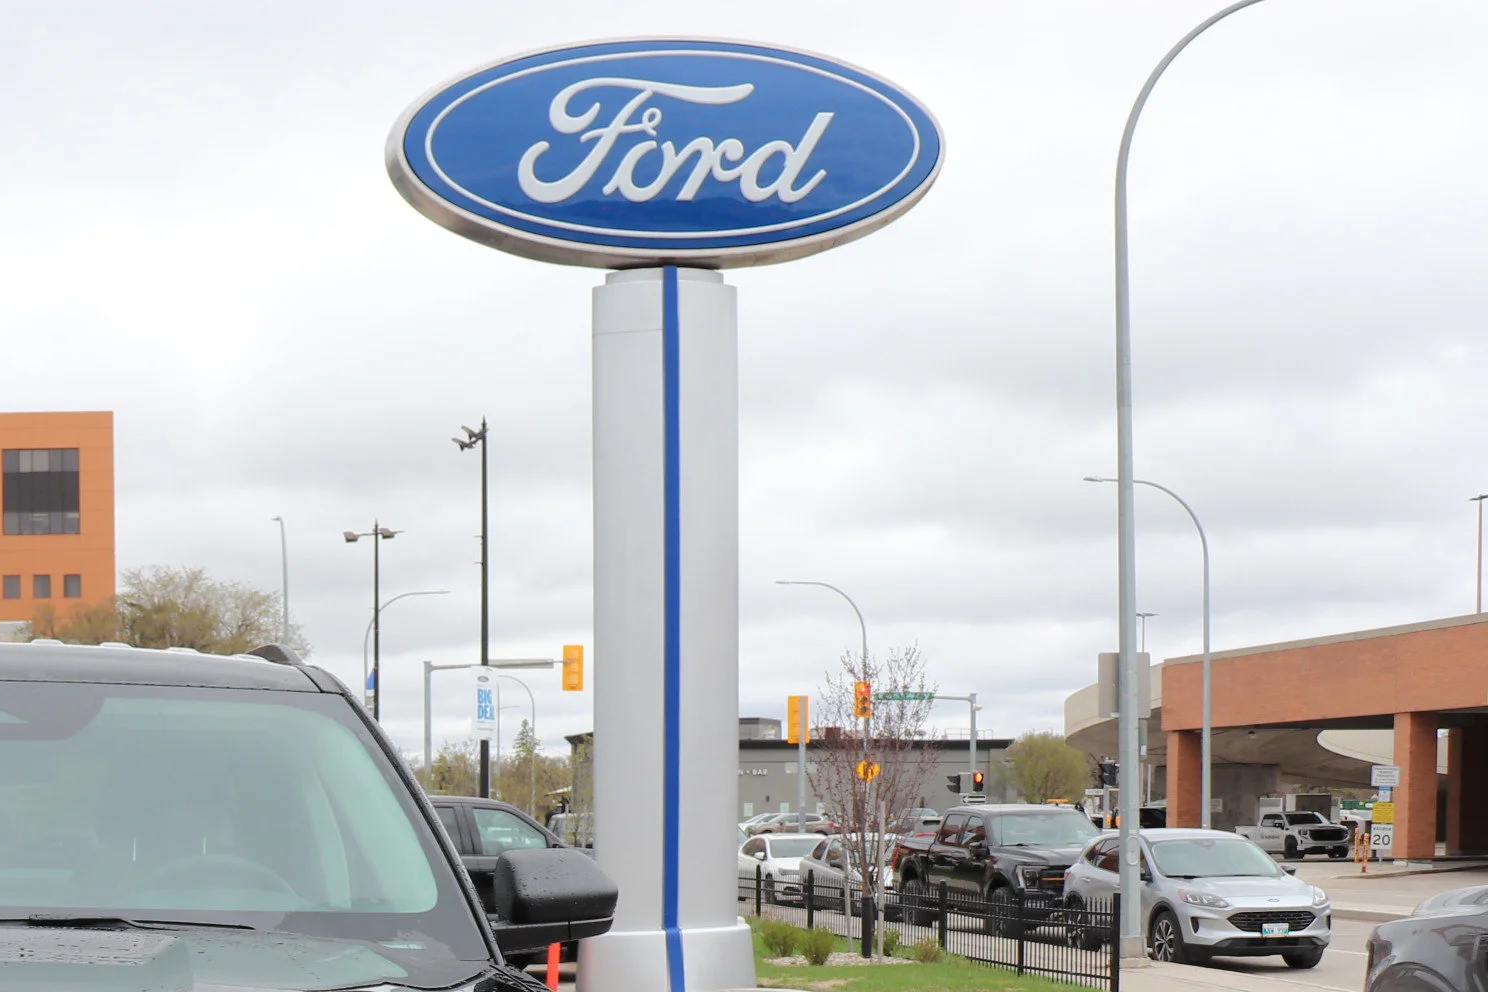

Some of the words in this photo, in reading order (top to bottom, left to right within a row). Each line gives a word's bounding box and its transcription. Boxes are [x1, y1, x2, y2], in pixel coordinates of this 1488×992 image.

[517, 76, 835, 203] Ford
[477, 688, 492, 704] BIG
[477, 704, 495, 720] DEAL
[1372, 834, 1391, 846] 20
